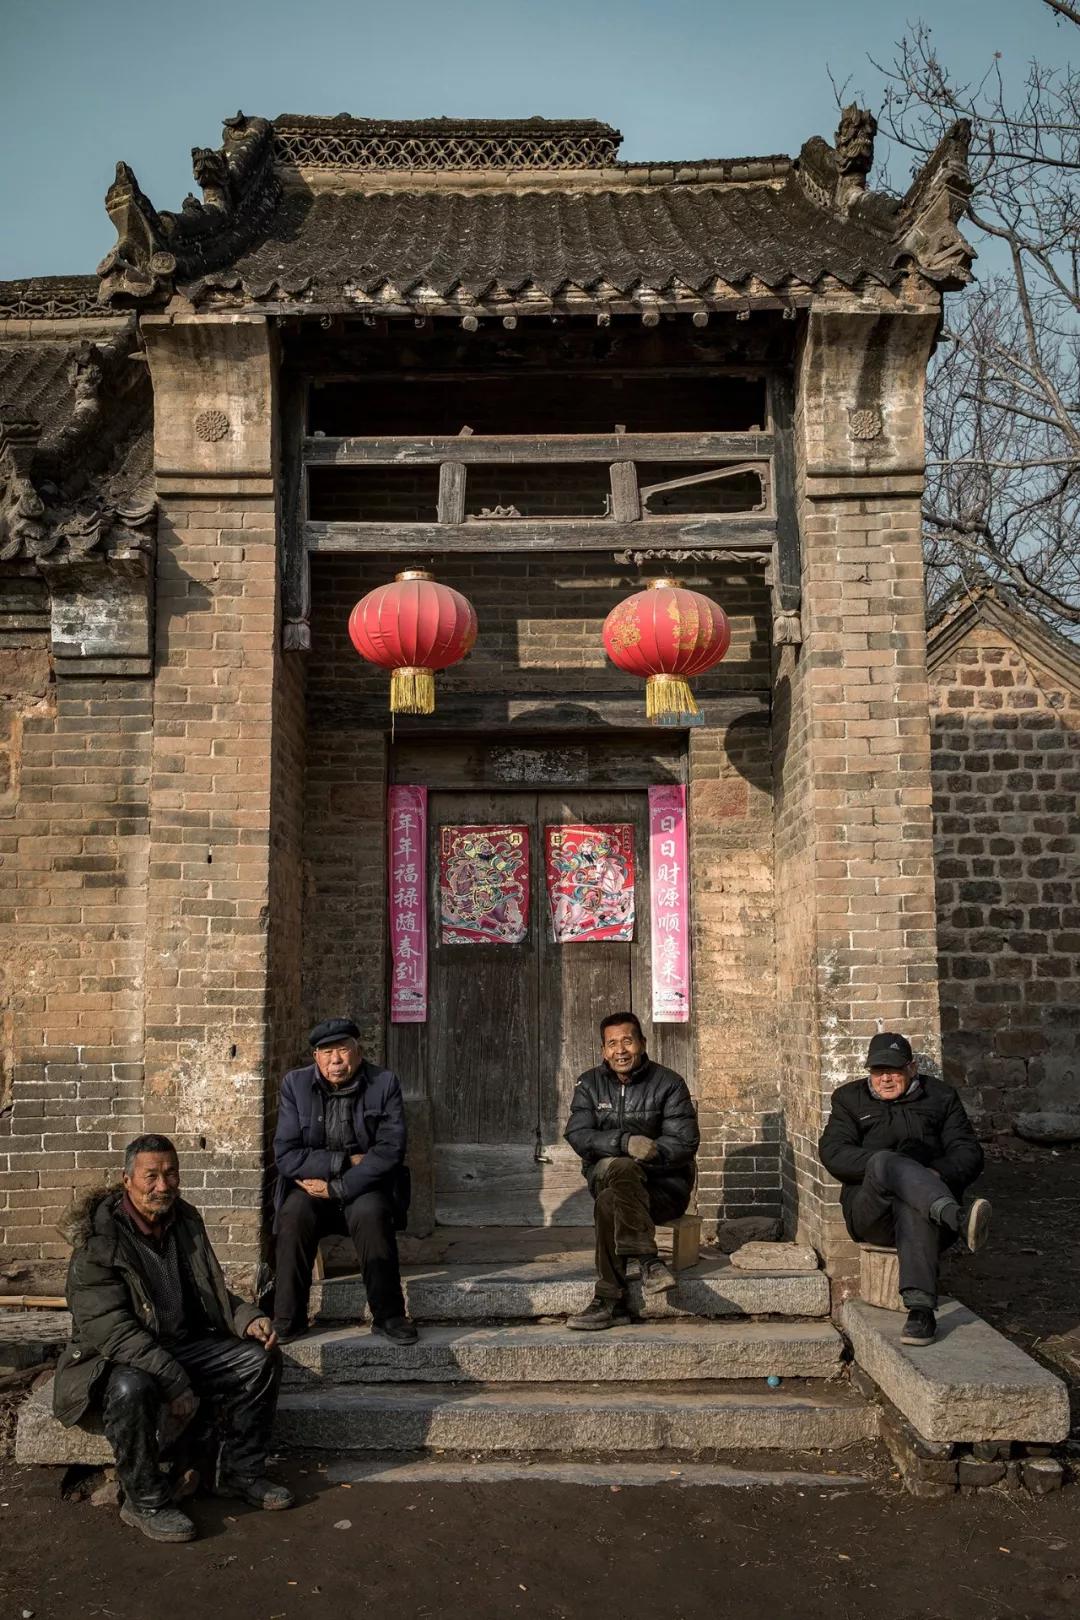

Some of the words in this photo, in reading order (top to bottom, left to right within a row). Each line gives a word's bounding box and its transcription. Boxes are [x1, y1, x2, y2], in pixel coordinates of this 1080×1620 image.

[511, 835, 520, 844] 月
[554, 835, 562, 844] 日
[393, 813, 421, 983] 年年福禄随春到
[657, 815, 681, 983] 日日财源顺意来
